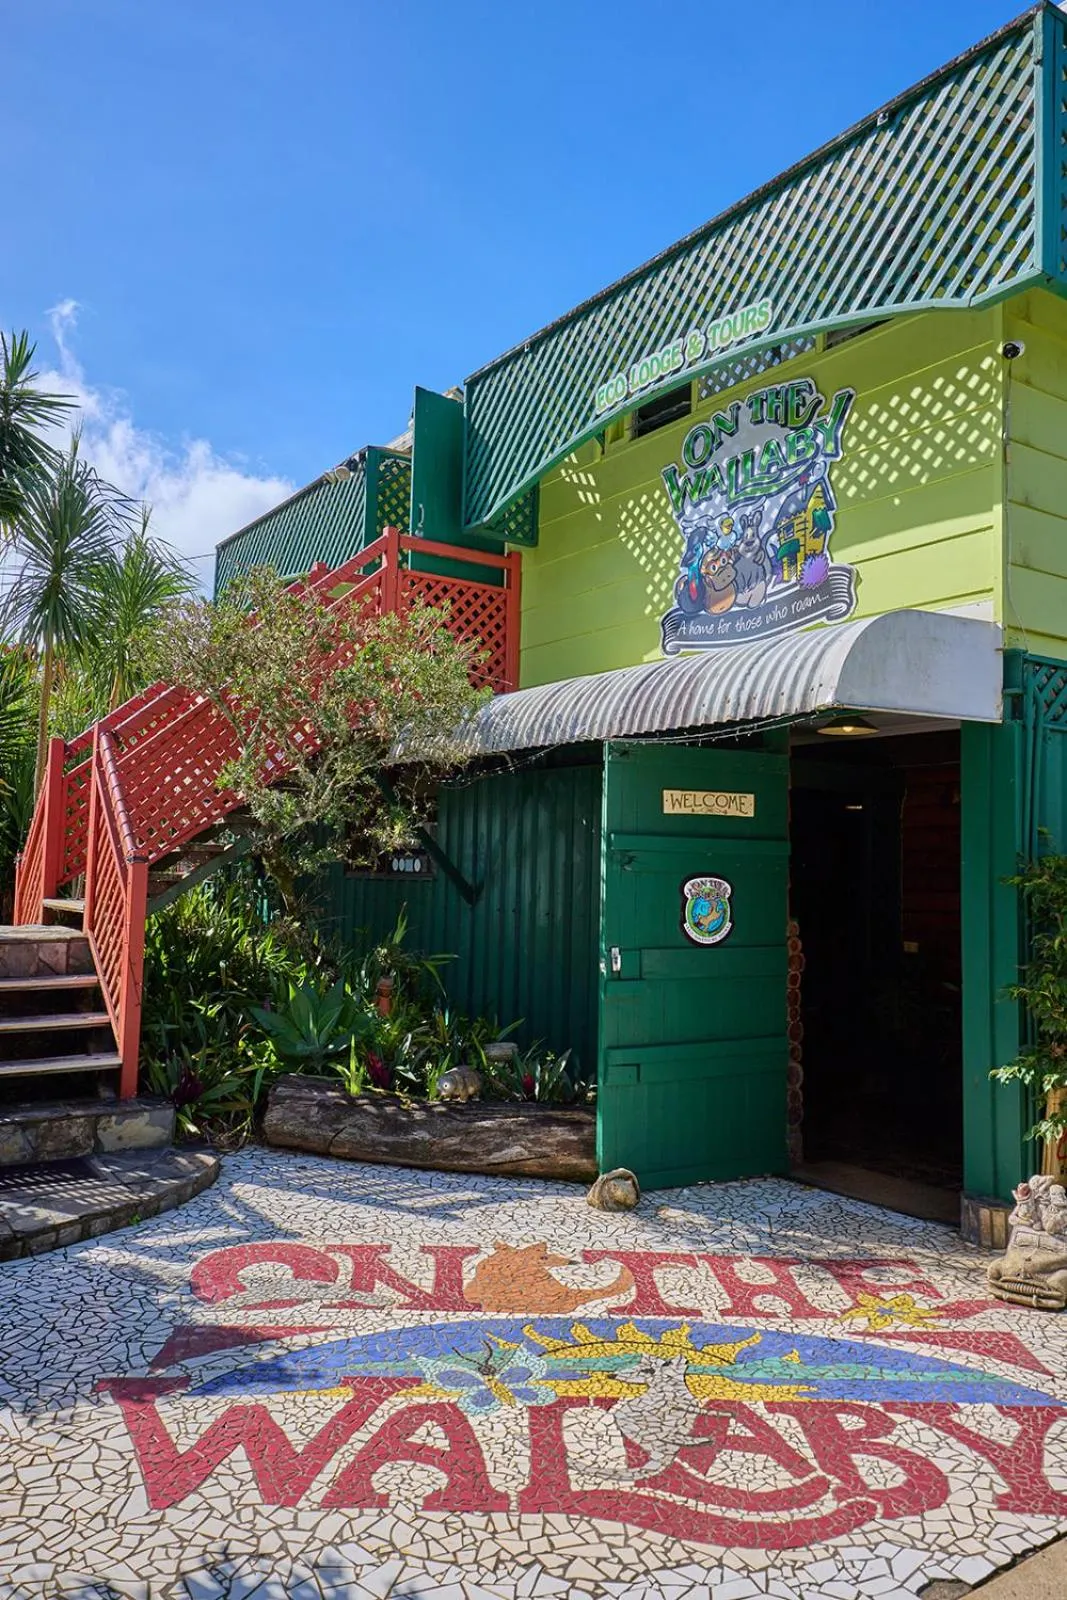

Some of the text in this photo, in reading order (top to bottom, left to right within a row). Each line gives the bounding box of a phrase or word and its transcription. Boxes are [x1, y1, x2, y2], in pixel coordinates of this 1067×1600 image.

[596, 300, 771, 412] ECO LODGE & TOURS
[662, 390, 854, 517] WALLABY
[683, 381, 824, 469] ON THE
[676, 620, 687, 637] A
[688, 620, 715, 636] home
[717, 619, 730, 635] for
[735, 614, 763, 632] those
[765, 604, 788, 625] who
[670, 793, 748, 815] WELCOME
[190, 1242, 1018, 1320] ON THE
